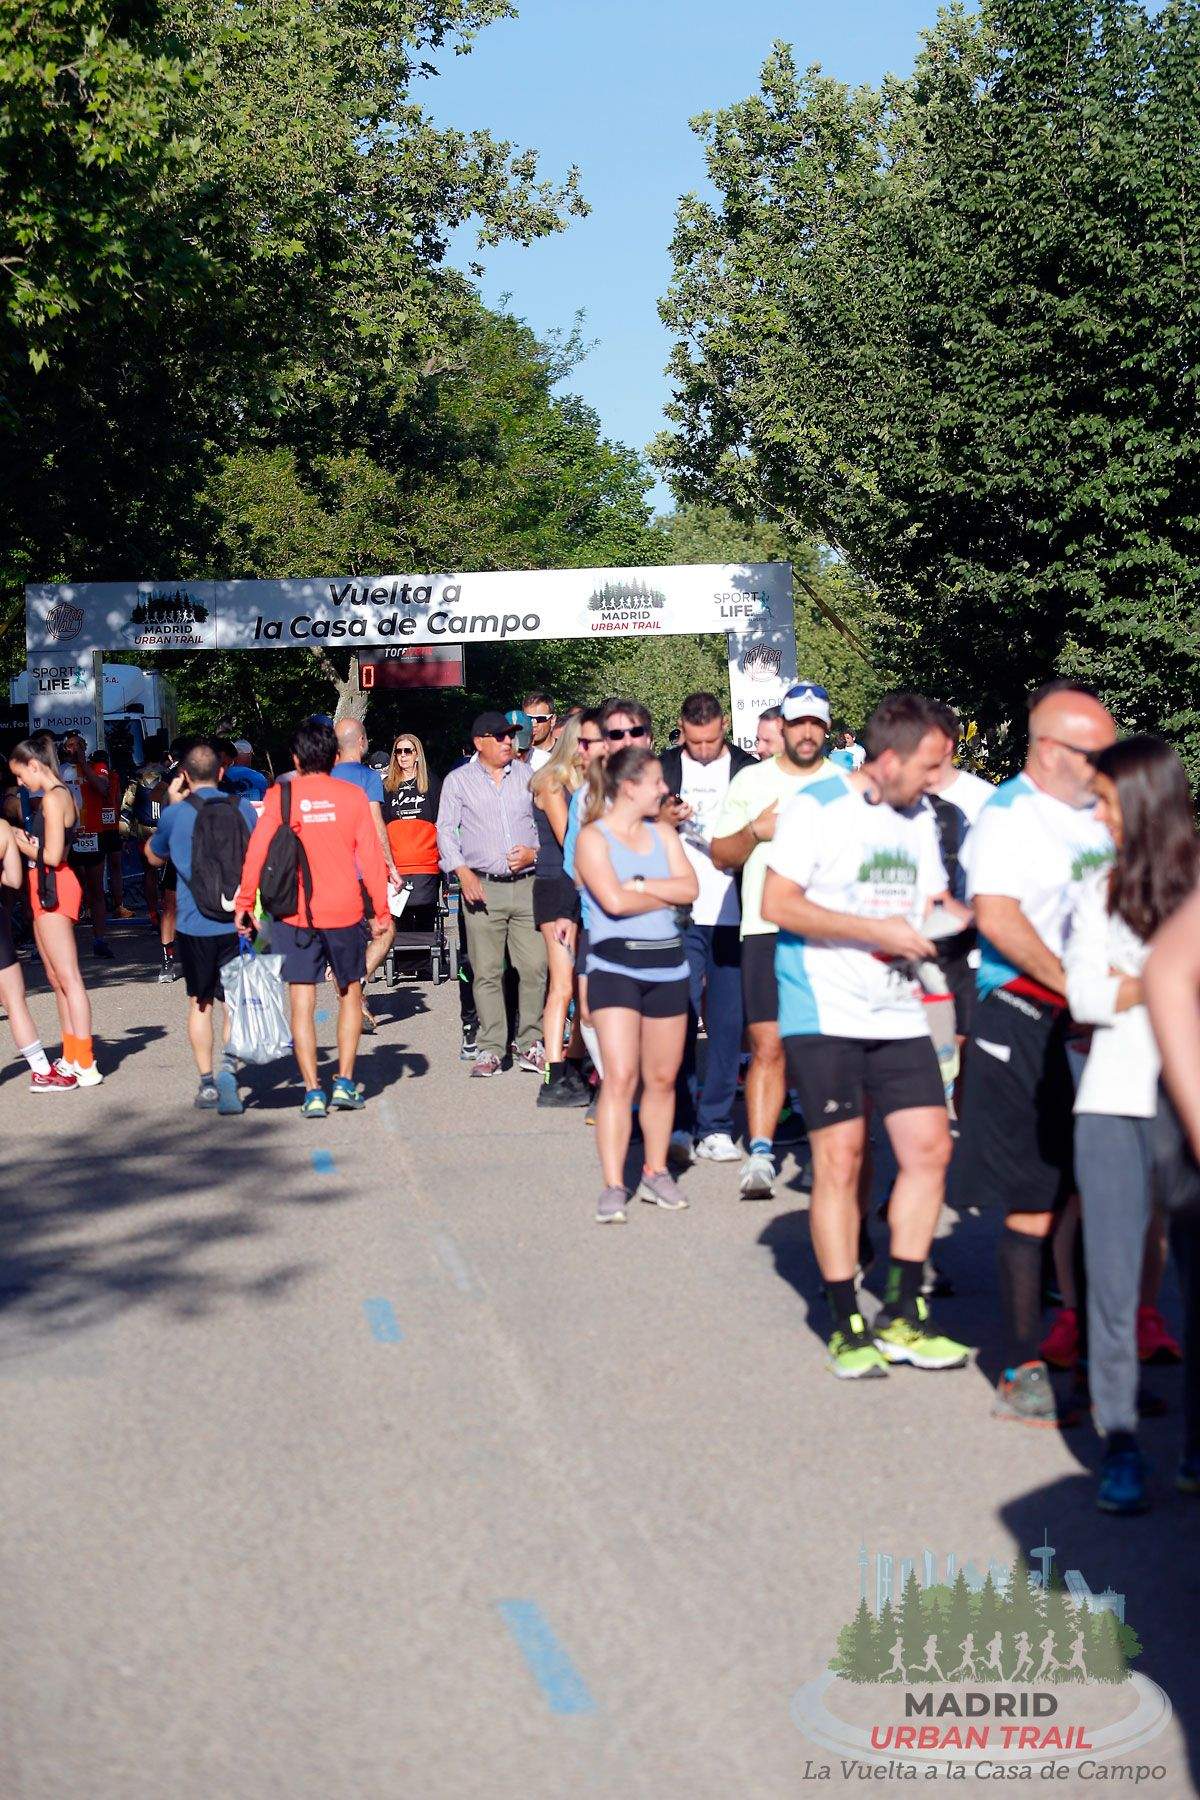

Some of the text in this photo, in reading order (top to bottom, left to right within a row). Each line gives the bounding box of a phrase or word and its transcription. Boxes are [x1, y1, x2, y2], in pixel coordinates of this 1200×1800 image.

[329, 581, 462, 607] Vuelta a
[713, 591, 759, 604] SPORT
[601, 610, 651, 621] MADRID
[720, 604, 753, 618] LIFE
[144, 625, 193, 635] MADRID
[254, 611, 541, 640] la Casa de Campo
[591, 620, 662, 631] URBAN TRAIL
[134, 635, 204, 645] URBAN TRAIL
[32, 666, 76, 679] SPORT
[362, 665, 375, 688] 0
[39, 678, 70, 691] LIFE
[751, 698, 783, 708] MADR
[47, 716, 92, 727] MADRID
